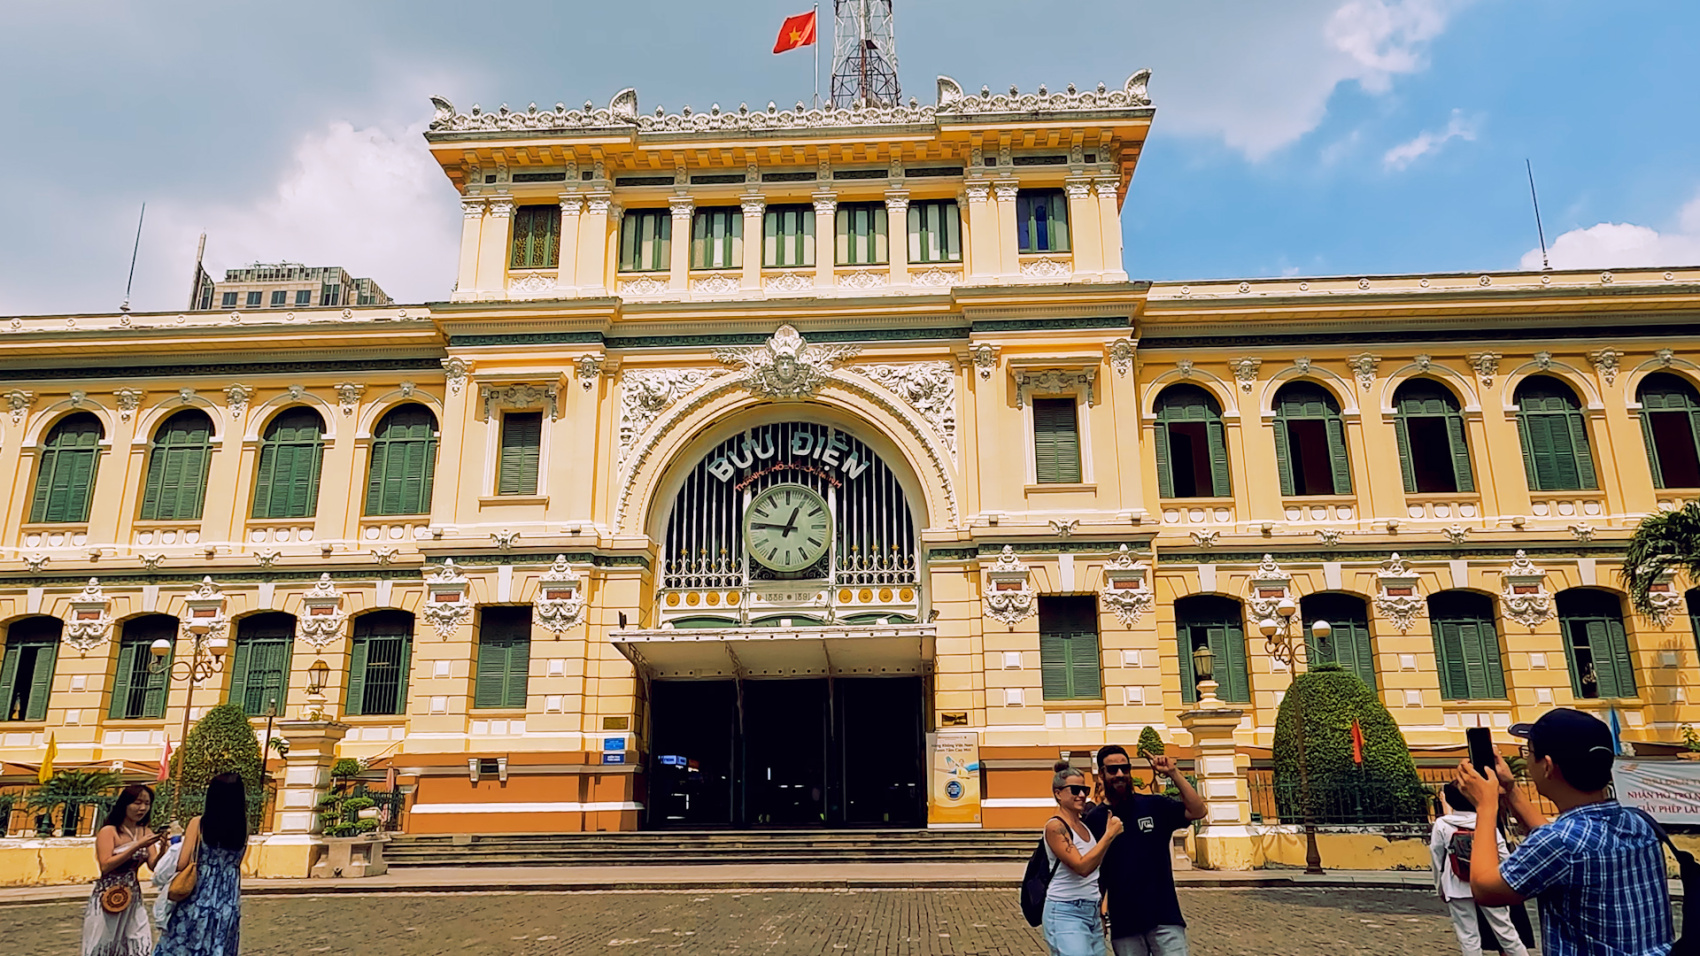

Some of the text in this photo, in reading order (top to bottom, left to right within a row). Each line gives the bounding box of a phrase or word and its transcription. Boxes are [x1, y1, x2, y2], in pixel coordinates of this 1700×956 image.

[707, 431, 871, 483] BƯU ĐIỆN
[765, 592, 811, 602] 1886 1891
[1659, 803, 1682, 814] PHÉP
